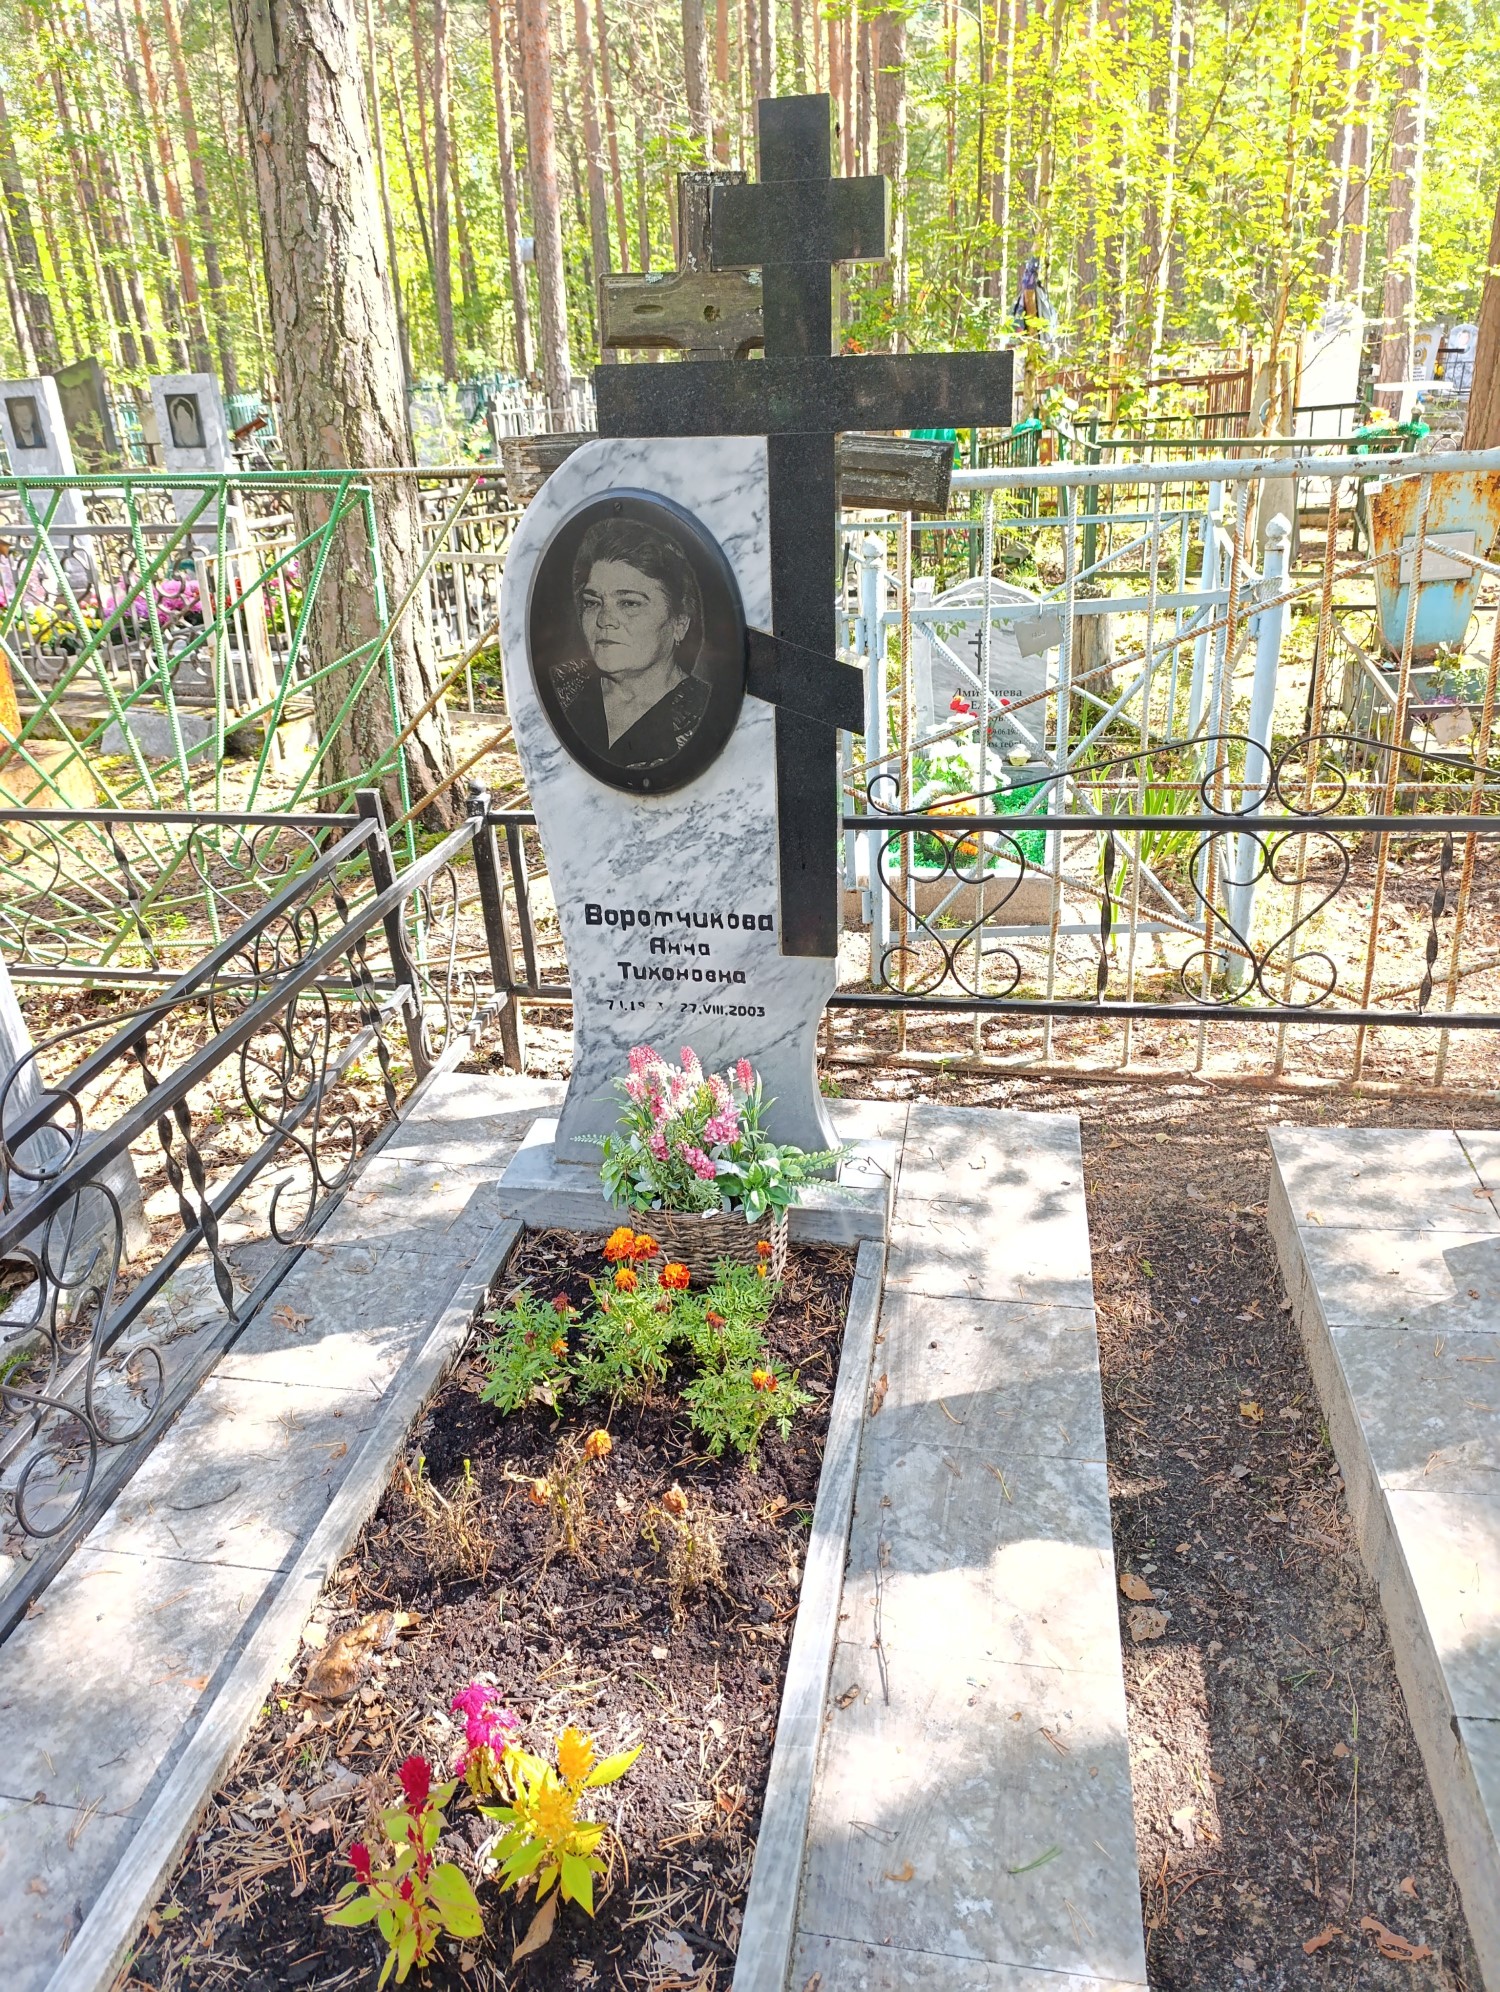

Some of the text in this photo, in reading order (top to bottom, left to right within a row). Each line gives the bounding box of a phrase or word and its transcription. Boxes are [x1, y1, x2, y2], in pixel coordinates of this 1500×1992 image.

[953, 687, 1022, 698] Дмииева
[584, 903, 774, 931] Воротчикова
[649, 937, 711, 956] Анна
[617, 961, 747, 984] Тихоновна
